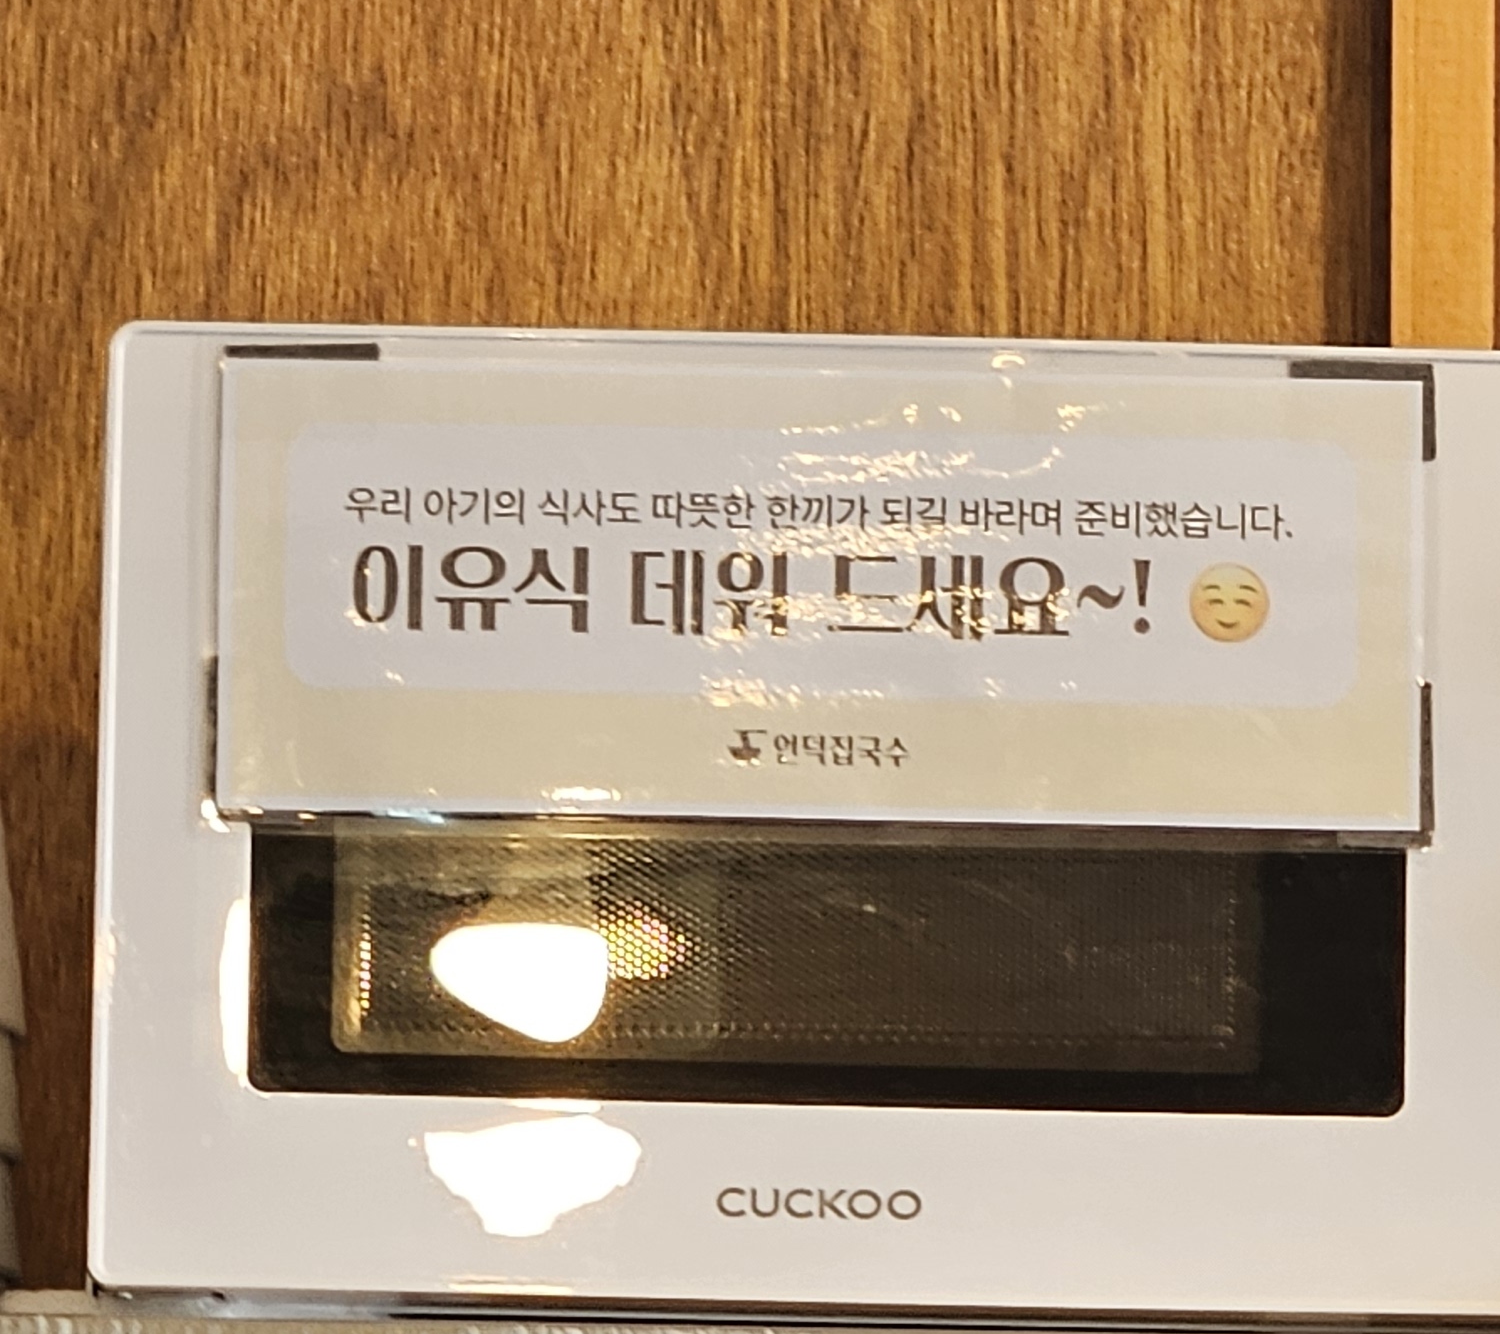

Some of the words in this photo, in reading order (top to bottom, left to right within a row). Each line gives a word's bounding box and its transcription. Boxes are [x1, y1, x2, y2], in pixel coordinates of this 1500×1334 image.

[345, 487, 411, 524] 우리
[424, 487, 525, 525] 아기의
[538, 488, 641, 526] 식사도
[651, 490, 754, 529] 따뜻한
[767, 494, 869, 530] 한끼가
[882, 496, 947, 530] 되길
[960, 498, 1062, 536] 바라며
[1074, 501, 1294, 540] 준비했습니다.
[352, 544, 590, 634] 이유식
[628, 549, 790, 637] 데워
[827, 554, 1152, 642] 드세요~!
[773, 733, 911, 768] 언덕집국수
[716, 1187, 922, 1220] CUCKOO
